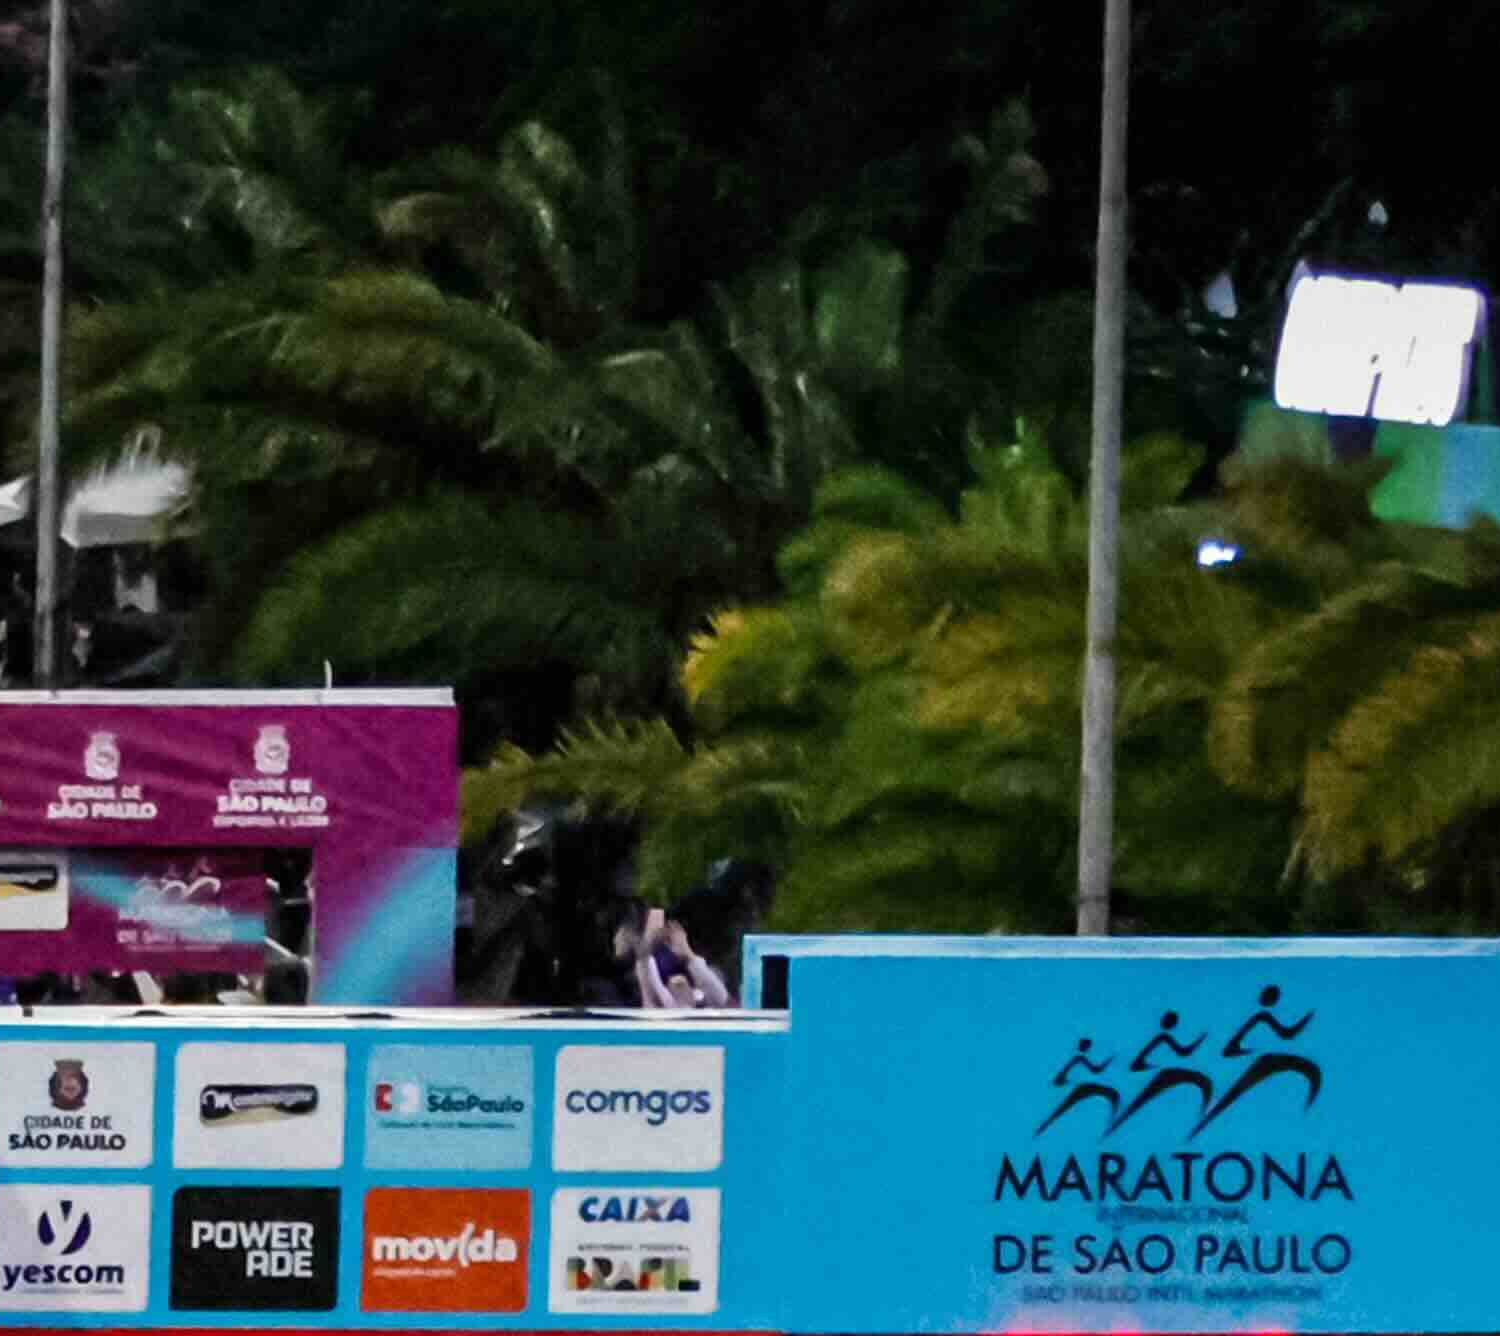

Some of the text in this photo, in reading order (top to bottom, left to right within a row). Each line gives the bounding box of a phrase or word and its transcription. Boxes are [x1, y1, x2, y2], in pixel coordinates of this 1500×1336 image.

[23, 1113, 113, 1131] CIDADE DE
[8, 1127, 127, 1152] SÃO PAULO
[992, 1151, 1355, 1201] MARATONA
[578, 1196, 691, 1224] CAIXA
[191, 1220, 315, 1250] POWER
[993, 1218, 1353, 1275] DE SÃO PAULO
[2, 1262, 124, 1291] yescom
[246, 1248, 314, 1279] ADE
[1204, 1285, 1322, 1305] MARATHON
